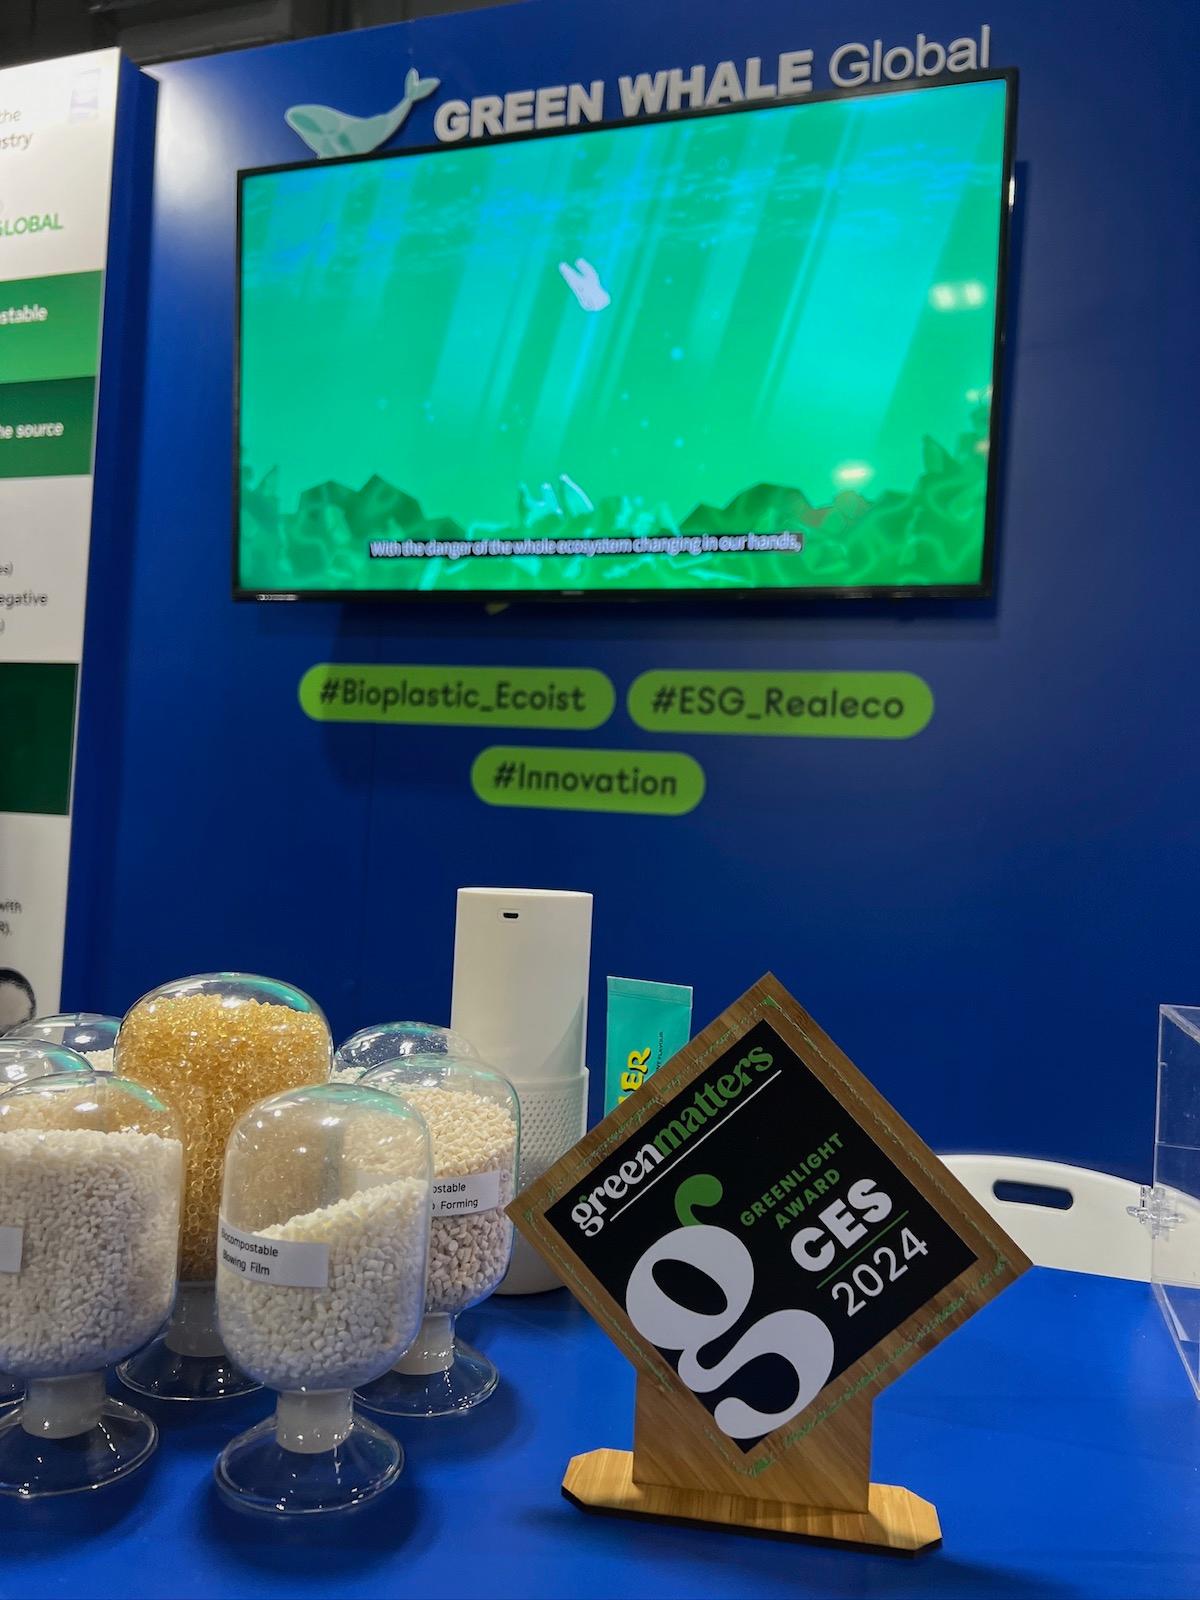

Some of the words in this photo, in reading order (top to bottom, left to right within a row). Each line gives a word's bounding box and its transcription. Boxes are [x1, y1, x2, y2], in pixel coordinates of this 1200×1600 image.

[434, 84, 605, 142] GREEN
[619, 49, 814, 118] WHALE
[827, 25, 991, 88] Global
[15, 421, 65, 439] source
[370, 541, 400, 556] With
[402, 539, 424, 556] the
[425, 539, 471, 560] danger
[472, 538, 488, 555] of
[488, 538, 512, 555] the
[512, 538, 556, 554] whole
[556, 537, 632, 557] ecosystem
[632, 535, 701, 556] changing
[702, 534, 718, 551] in
[719, 534, 746, 551] our
[320, 678, 586, 714] #Bioplastic_Ecoist
[652, 684, 905, 721] #ESG_Realeco
[493, 761, 678, 797] #Innovation
[617, 1047, 651, 1105] ER
[571, 1046, 774, 1238] greenmatters
[739, 1131, 846, 1228] GREENLIGHT
[774, 1167, 842, 1231] AWARD
[440, 1199, 479, 1210] Forming
[790, 1178, 894, 1273] CES
[250, 1261, 270, 1276] Film
[831, 1226, 930, 1318] 2024
